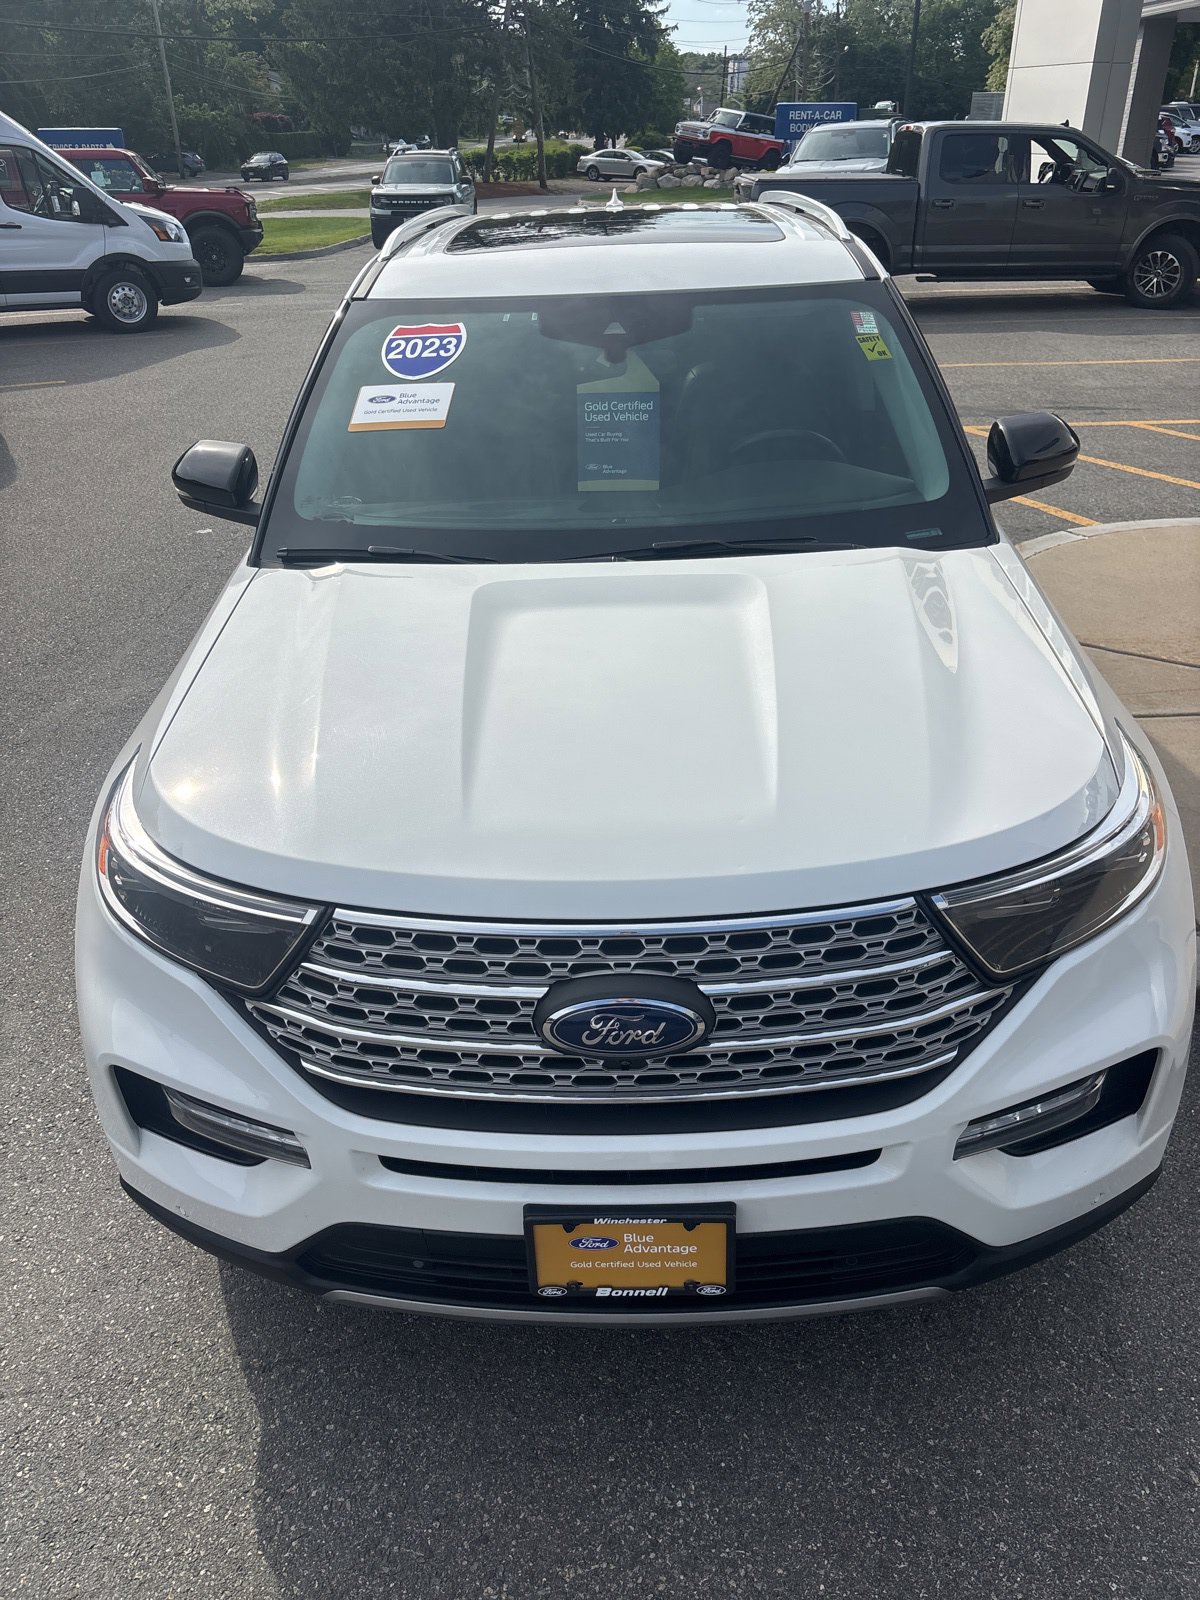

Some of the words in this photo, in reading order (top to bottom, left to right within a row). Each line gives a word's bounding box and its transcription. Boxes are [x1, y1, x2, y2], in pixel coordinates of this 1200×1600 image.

[788, 110, 842, 120] RENT-A-CAR
[857, 335, 880, 344] SAFETY
[386, 337, 458, 360] 2023
[397, 397, 440, 405] Advantage
[584, 401, 609, 411] Gold
[610, 400, 654, 411] Certified
[584, 412, 611, 422] Used
[613, 411, 649, 421] Vehicle
[581, 1013, 667, 1046] Ford
[593, 1217, 667, 1225] Winchester
[623, 1233, 655, 1243] Blue
[623, 1243, 698, 1255] Advantage
[570, 1260, 592, 1269] Gold
[594, 1260, 635, 1268] Certified
[637, 1260, 662, 1268] Used
[664, 1260, 698, 1268] Vehicle
[595, 1287, 669, 1298] Bonnell
